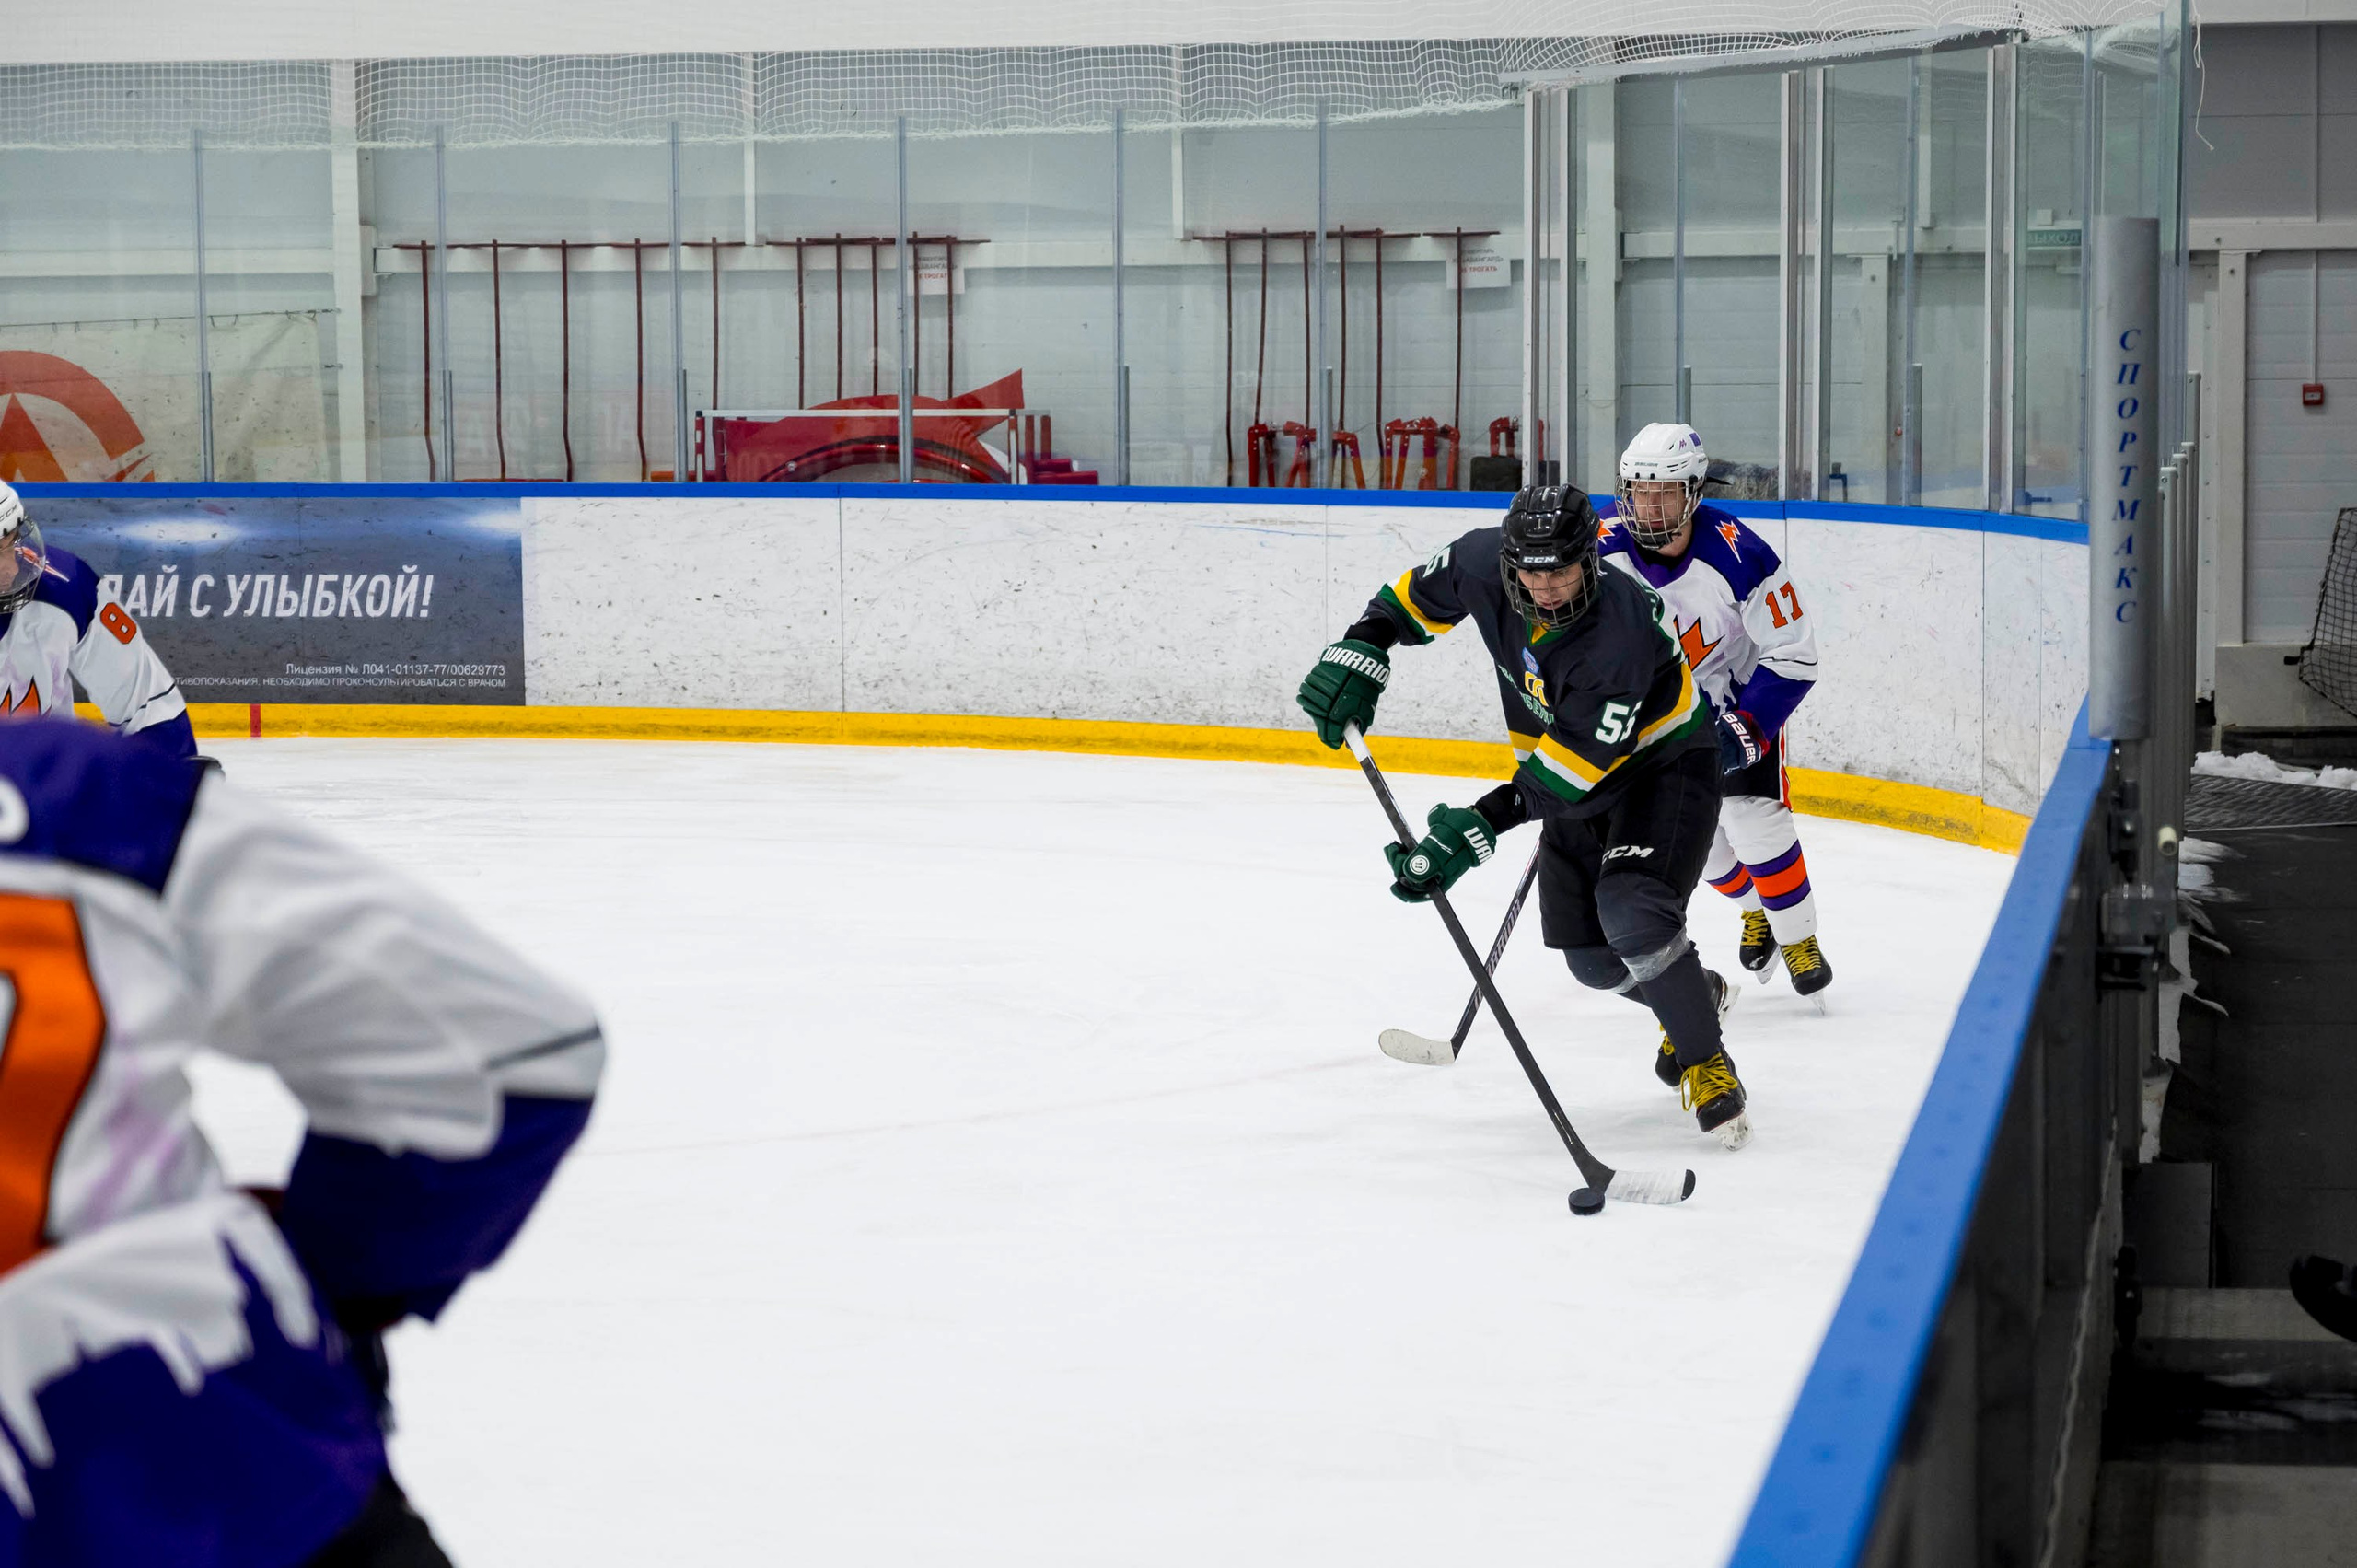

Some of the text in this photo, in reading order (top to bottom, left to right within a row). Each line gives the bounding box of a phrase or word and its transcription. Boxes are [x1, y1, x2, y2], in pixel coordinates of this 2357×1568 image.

[2112, 328, 2142, 623] СПОРТМАКС
[1523, 555, 1559, 563] CCM
[189, 573, 215, 618] С
[223, 564, 434, 618] УЛЫБКОЙ!
[1765, 581, 1804, 629] 17
[99, 602, 137, 645] 8
[262, 677, 330, 687] НЕОБХОДИМО
[332, 677, 457, 687] ПРОКОНСУЛЬТИРОВАТЬСЯ
[459, 677, 466, 687] С
[468, 678, 506, 688] ВРАЧОМ
[285, 663, 342, 676] Лицензия
[345, 663, 359, 675] №
[1322, 646, 1390, 686] WARRIO
[1723, 713, 1756, 764] BAUER
[1463, 826, 1492, 864] WA
